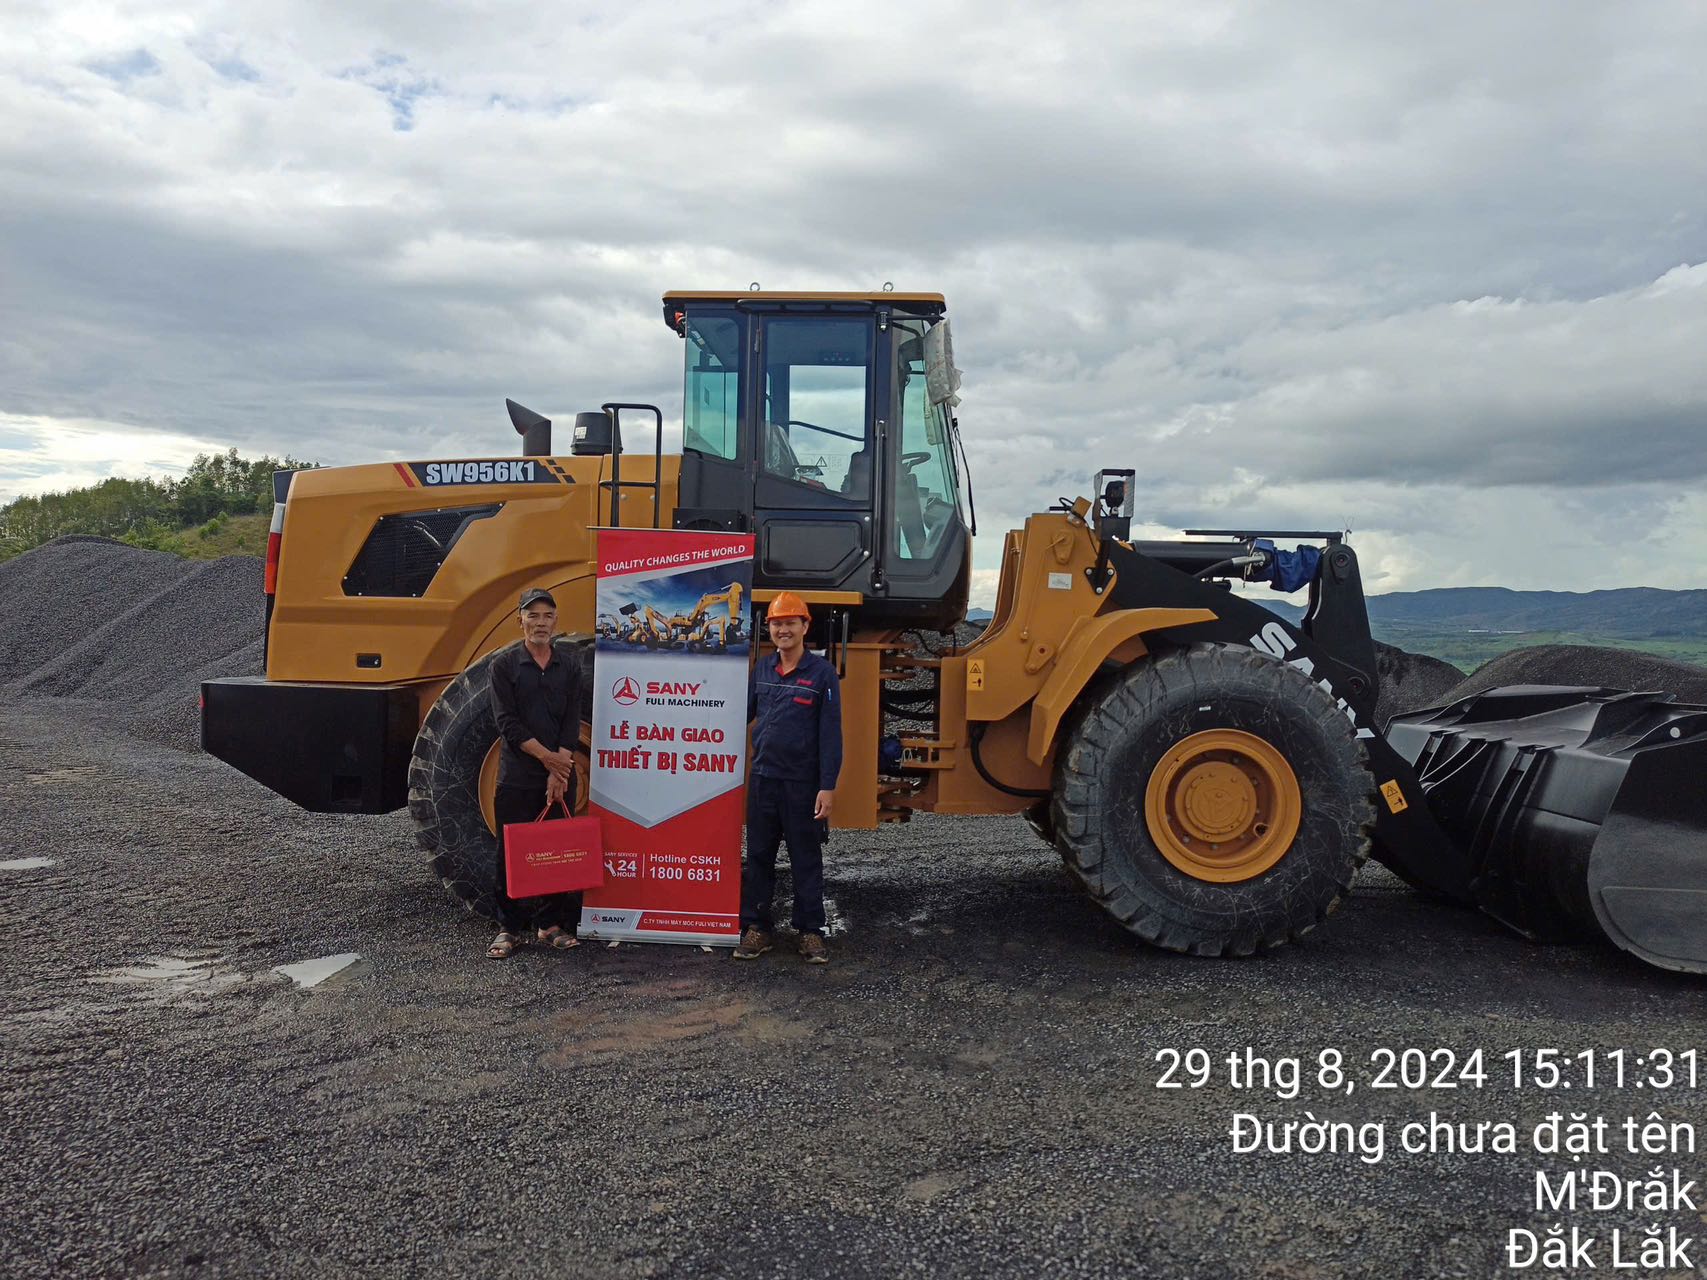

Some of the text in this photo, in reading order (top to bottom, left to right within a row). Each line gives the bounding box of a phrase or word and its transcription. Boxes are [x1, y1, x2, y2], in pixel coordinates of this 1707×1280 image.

[426, 461, 535, 484] SW956K1
[605, 544, 746, 573] QUALITY CHANGES THE WORLD
[646, 681, 701, 695] SANY
[645, 697, 726, 708] FULI MACHINERY
[610, 720, 725, 743] LỄ BÀN GIAO
[597, 744, 738, 775] THIẾT BỊ SANY
[617, 859, 638, 872] 24
[650, 853, 721, 865] Hotline CSKH
[649, 866, 721, 882] 1800 6831
